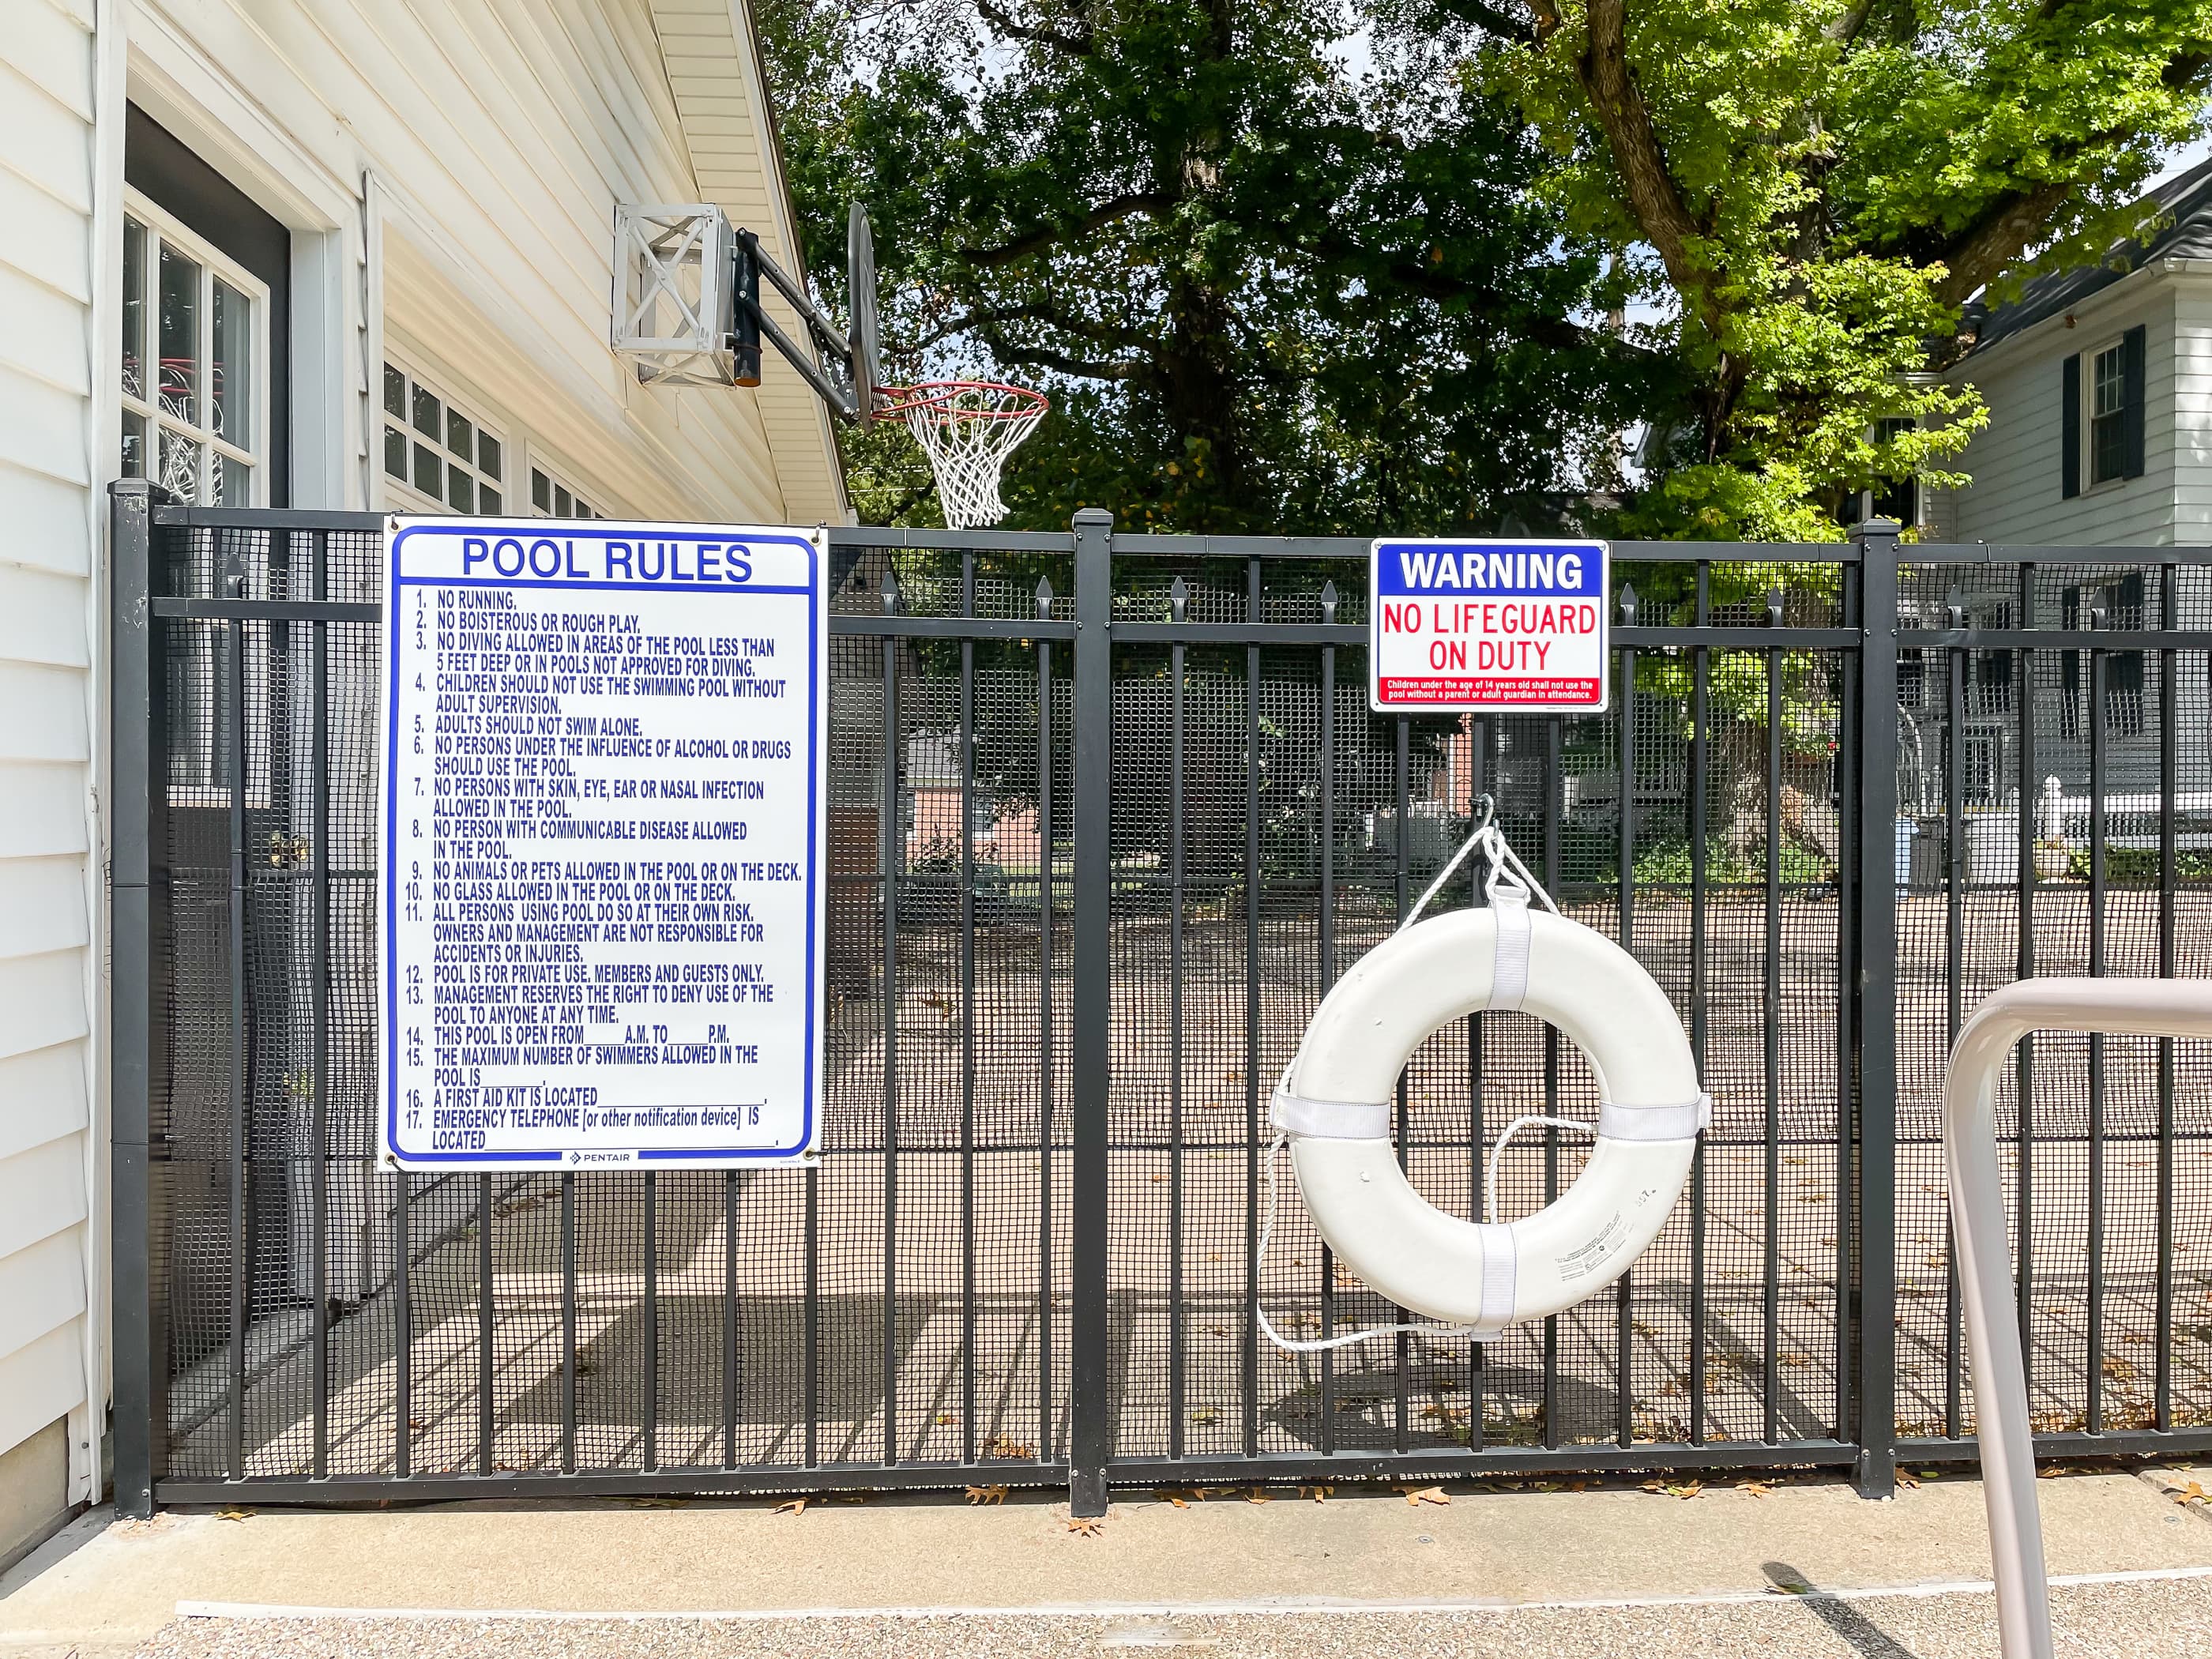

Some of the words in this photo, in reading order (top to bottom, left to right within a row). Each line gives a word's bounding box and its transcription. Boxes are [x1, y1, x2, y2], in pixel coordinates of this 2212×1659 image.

[463, 539, 589, 578] POOL
[606, 541, 752, 582] RULES
[1400, 552, 1582, 589] WARNING
[417, 589, 426, 607] 1.
[438, 589, 453, 608] NO
[459, 590, 516, 609] RUNNING.
[416, 610, 426, 628] 2.
[438, 611, 454, 629] NO
[460, 611, 536, 630] BOISTEROUS
[541, 613, 558, 631] OR
[562, 614, 604, 632] ROUGH
[609, 615, 639, 633] PLAY.
[1385, 603, 1421, 633] NO
[1434, 604, 1595, 634] LIFEGUARD
[416, 631, 426, 649] 3.
[438, 631, 453, 649] NO
[460, 632, 501, 651] DIVING
[506, 633, 562, 652] ALLOWED
[567, 634, 578, 653] IN
[584, 635, 623, 653] AREAS
[627, 636, 641, 653] OF
[646, 636, 669, 654] THE
[674, 637, 705, 655] POOL
[709, 638, 738, 656] LESS
[742, 638, 773, 656] THAN
[437, 653, 442, 670] 5
[448, 653, 476, 671] FEET
[481, 653, 510, 672] DEEP
[515, 654, 530, 672] OR
[536, 654, 546, 672] IN
[551, 655, 589, 673] POOLS
[593, 656, 616, 674] NOT
[620, 656, 681, 675] APPROVED
[686, 657, 708, 675] FOR
[713, 658, 754, 676] DIVING.
[1430, 640, 1466, 670] ON
[1479, 641, 1551, 670] DUTY
[416, 672, 424, 690] 4.
[437, 673, 495, 692] CHILDREN
[501, 675, 547, 693] SHOULD
[553, 675, 576, 694] NOT
[581, 676, 602, 694] USE
[607, 677, 629, 694] THE
[634, 677, 694, 696] SWIMMING
[699, 679, 728, 696] POOL
[732, 679, 785, 698] WITHOUT
[1389, 690, 1405, 700] pool
[1445, 690, 1469, 700] parent
[1482, 690, 1501, 698] adult
[1503, 690, 1536, 701] guardian
[1539, 690, 1545, 698] in
[1460, 682, 1473, 690] age
[1476, 680, 1483, 689] of
[1485, 680, 1493, 689] 14
[1495, 682, 1516, 690] years
[1518, 680, 1529, 689] old
[436, 694, 474, 713] ADULT
[479, 695, 561, 713] SUPERVISION.
[415, 714, 423, 732] 5.
[435, 715, 481, 733] ADULTS
[486, 716, 533, 734] SHOULD
[538, 717, 561, 734] NOT
[566, 717, 596, 735] SWIM
[600, 717, 641, 735] ALONE.
[414, 735, 423, 754] 6.
[435, 735, 451, 754] NO
[457, 736, 510, 754] PERSONS
[516, 736, 555, 755] UNDER
[560, 738, 582, 755] THE
[587, 738, 651, 757] INFLUENCE
[656, 739, 670, 757] OF
[675, 739, 728, 758] ALCOHOL
[732, 740, 747, 758] OR
[752, 740, 790, 758] DRUGS
[434, 757, 482, 775] SHOULD
[487, 757, 510, 775] USE
[514, 758, 536, 776] THE
[542, 758, 575, 776] POOL.
[415, 777, 423, 796] 7.
[434, 777, 450, 796] NO
[455, 777, 510, 796] PERSONS
[514, 778, 544, 796] WITH
[548, 779, 579, 801] SKIN,
[585, 779, 609, 802] EYE,
[614, 780, 636, 797] EAR
[641, 780, 656, 798] OR
[660, 780, 698, 798] NASAL
[702, 781, 763, 799] INFECTION
[433, 798, 489, 817] ALLOWED
[494, 799, 505, 817] IN
[510, 799, 532, 817] THE
[537, 799, 571, 818] POOL.
[412, 819, 422, 837] 8.
[434, 819, 450, 837] NO
[455, 819, 502, 837] PERSON
[506, 820, 536, 838] WITH
[540, 820, 635, 839] COMMUNICABLE
[640, 821, 688, 839] DISEASE
[692, 822, 746, 840] ALLOWED
[434, 840, 445, 858] IN
[450, 841, 472, 858] THE
[477, 841, 511, 859] POOL.
[412, 861, 421, 879] 9.
[434, 861, 450, 879] NO
[454, 861, 506, 879] ANIMALS
[511, 862, 527, 879] OR
[532, 862, 560, 880] PETS
[564, 862, 619, 880] ALLOWED
[624, 862, 635, 880] IN
[640, 862, 662, 880] THE
[667, 862, 697, 880] POOL
[702, 862, 717, 880] OR
[721, 863, 736, 880] ON
[741, 863, 763, 880] THE
[768, 863, 800, 880] DECK.
[406, 965, 422, 983] 12.
[434, 965, 465, 983] POOL
[470, 965, 480, 983] IS
[485, 965, 507, 983] FOR
[512, 965, 560, 983] PRIVATE
[565, 965, 590, 983] USE.
[595, 965, 651, 982] MEMBERS
[655, 965, 679, 982] AND
[683, 964, 728, 982] GUESTS
[732, 964, 763, 982] ONLY.
[407, 1048, 423, 1066] 15.
[434, 1048, 457, 1066] THE
[462, 1047, 518, 1065] MAXIMUM
[524, 1047, 572, 1065] NUMBER
[577, 1046, 591, 1064] OF
[596, 1046, 657, 1064] SWIMMERS
[662, 1045, 716, 1063] ALLOWED
[720, 1045, 731, 1063] IN
[735, 1045, 757, 1063] THE
[406, 1111, 421, 1128] 17.
[434, 1109, 506, 1127] EMERGENCY
[510, 1108, 578, 1127] TELEPHONE
[583, 1108, 597, 1129] [or
[602, 1108, 630, 1126] other
[634, 1108, 697, 1126] notification
[702, 1107, 740, 1127] device]
[749, 1107, 758, 1124] IS
[584, 1153, 630, 1162] PENTAIR
